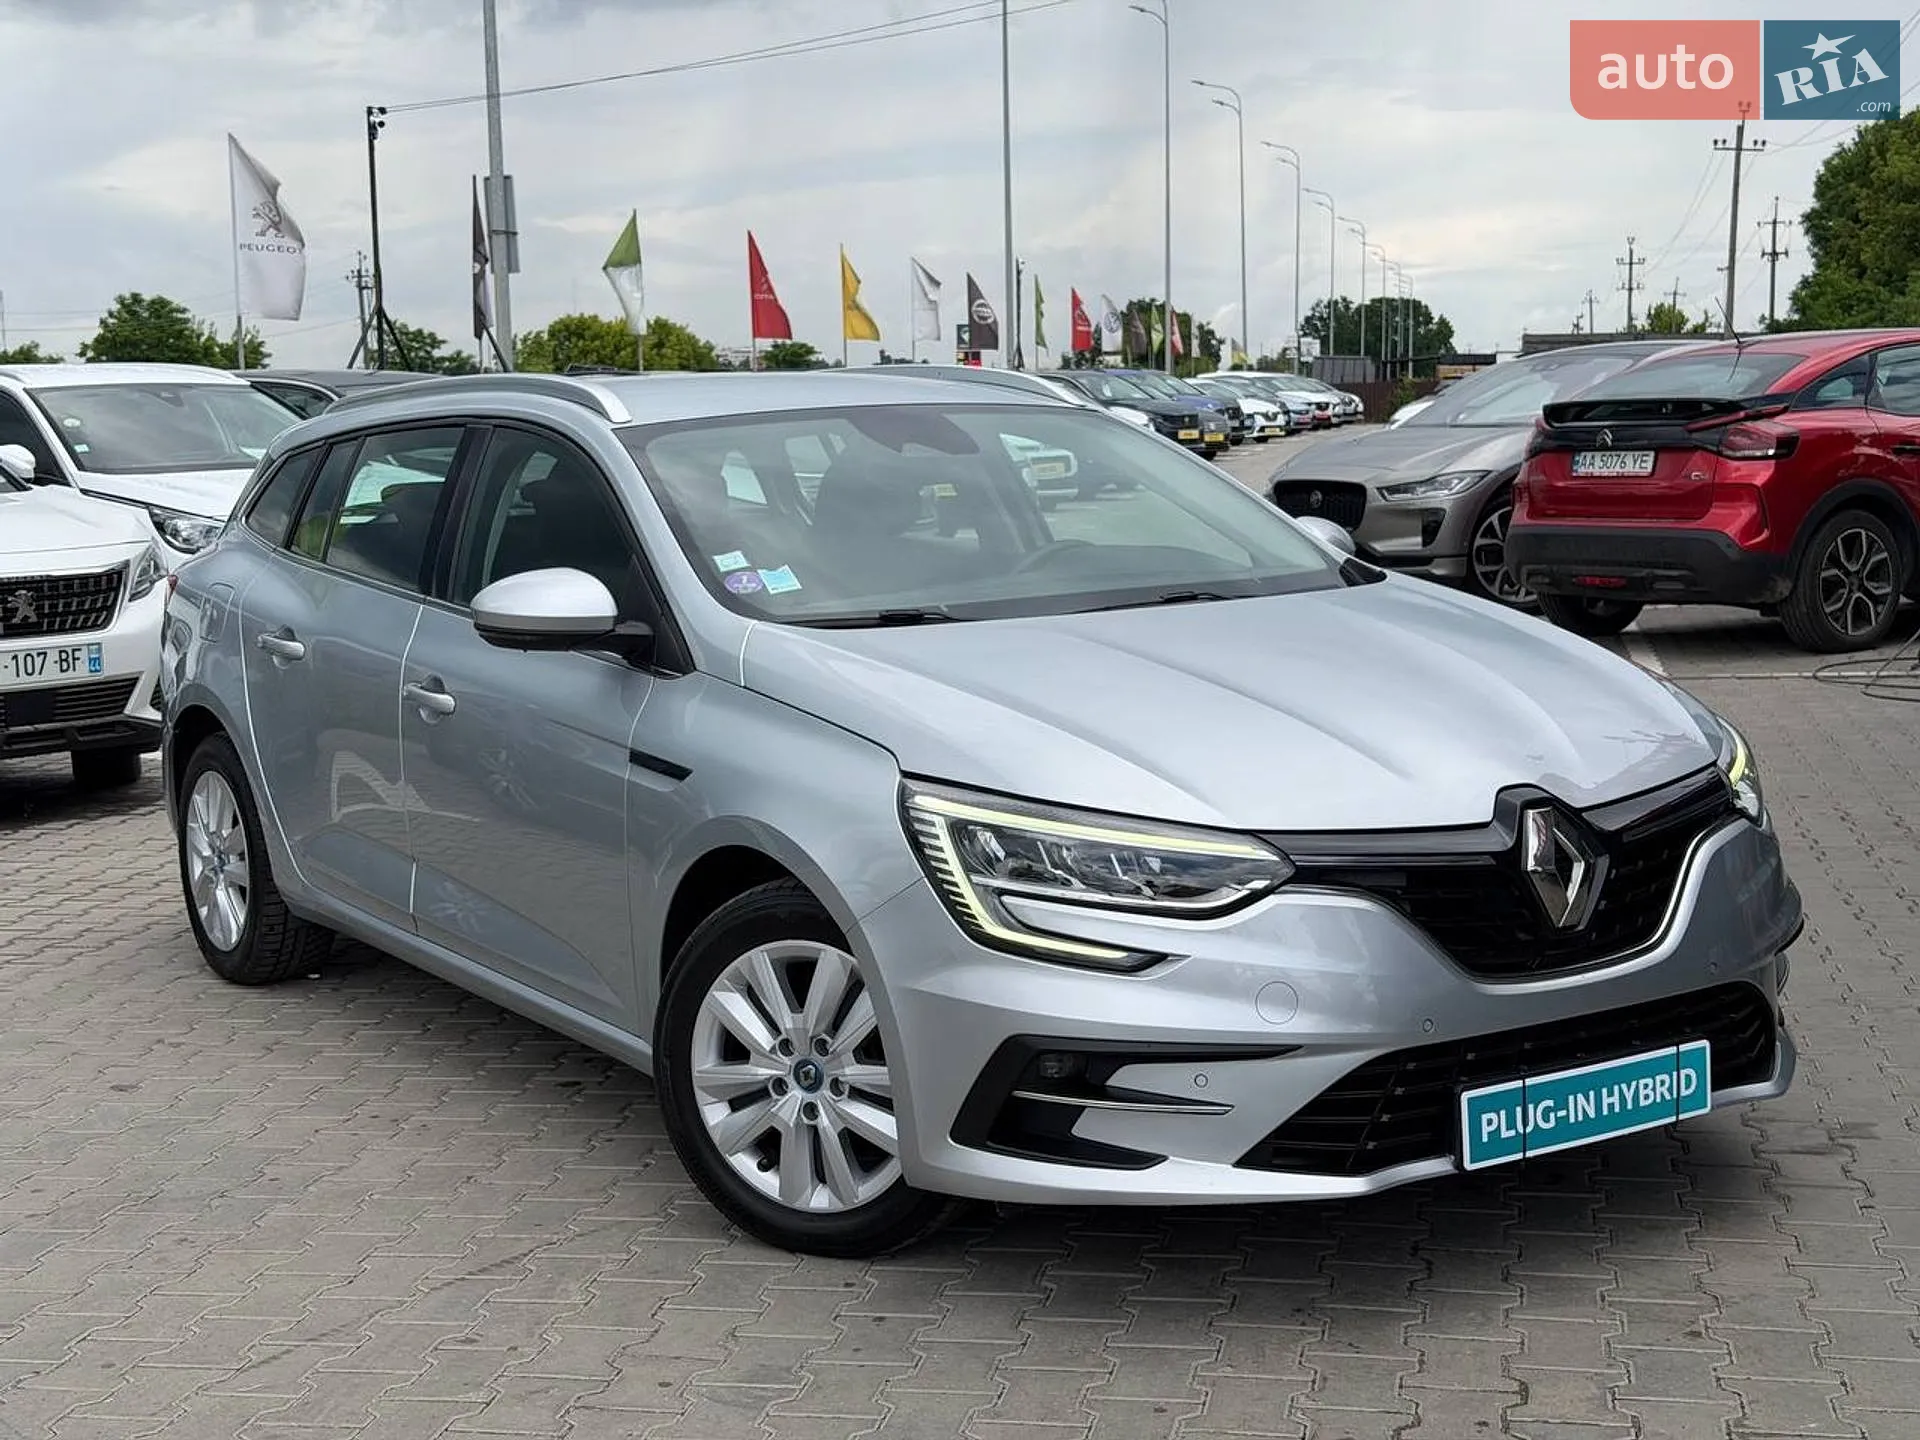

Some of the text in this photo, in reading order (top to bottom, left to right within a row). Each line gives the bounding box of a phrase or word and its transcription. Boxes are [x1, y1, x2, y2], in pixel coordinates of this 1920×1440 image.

[1580, 454, 1649, 469] AA 5076 YE
[1481, 1067, 1697, 1143] PLUG-IN HYBRID
